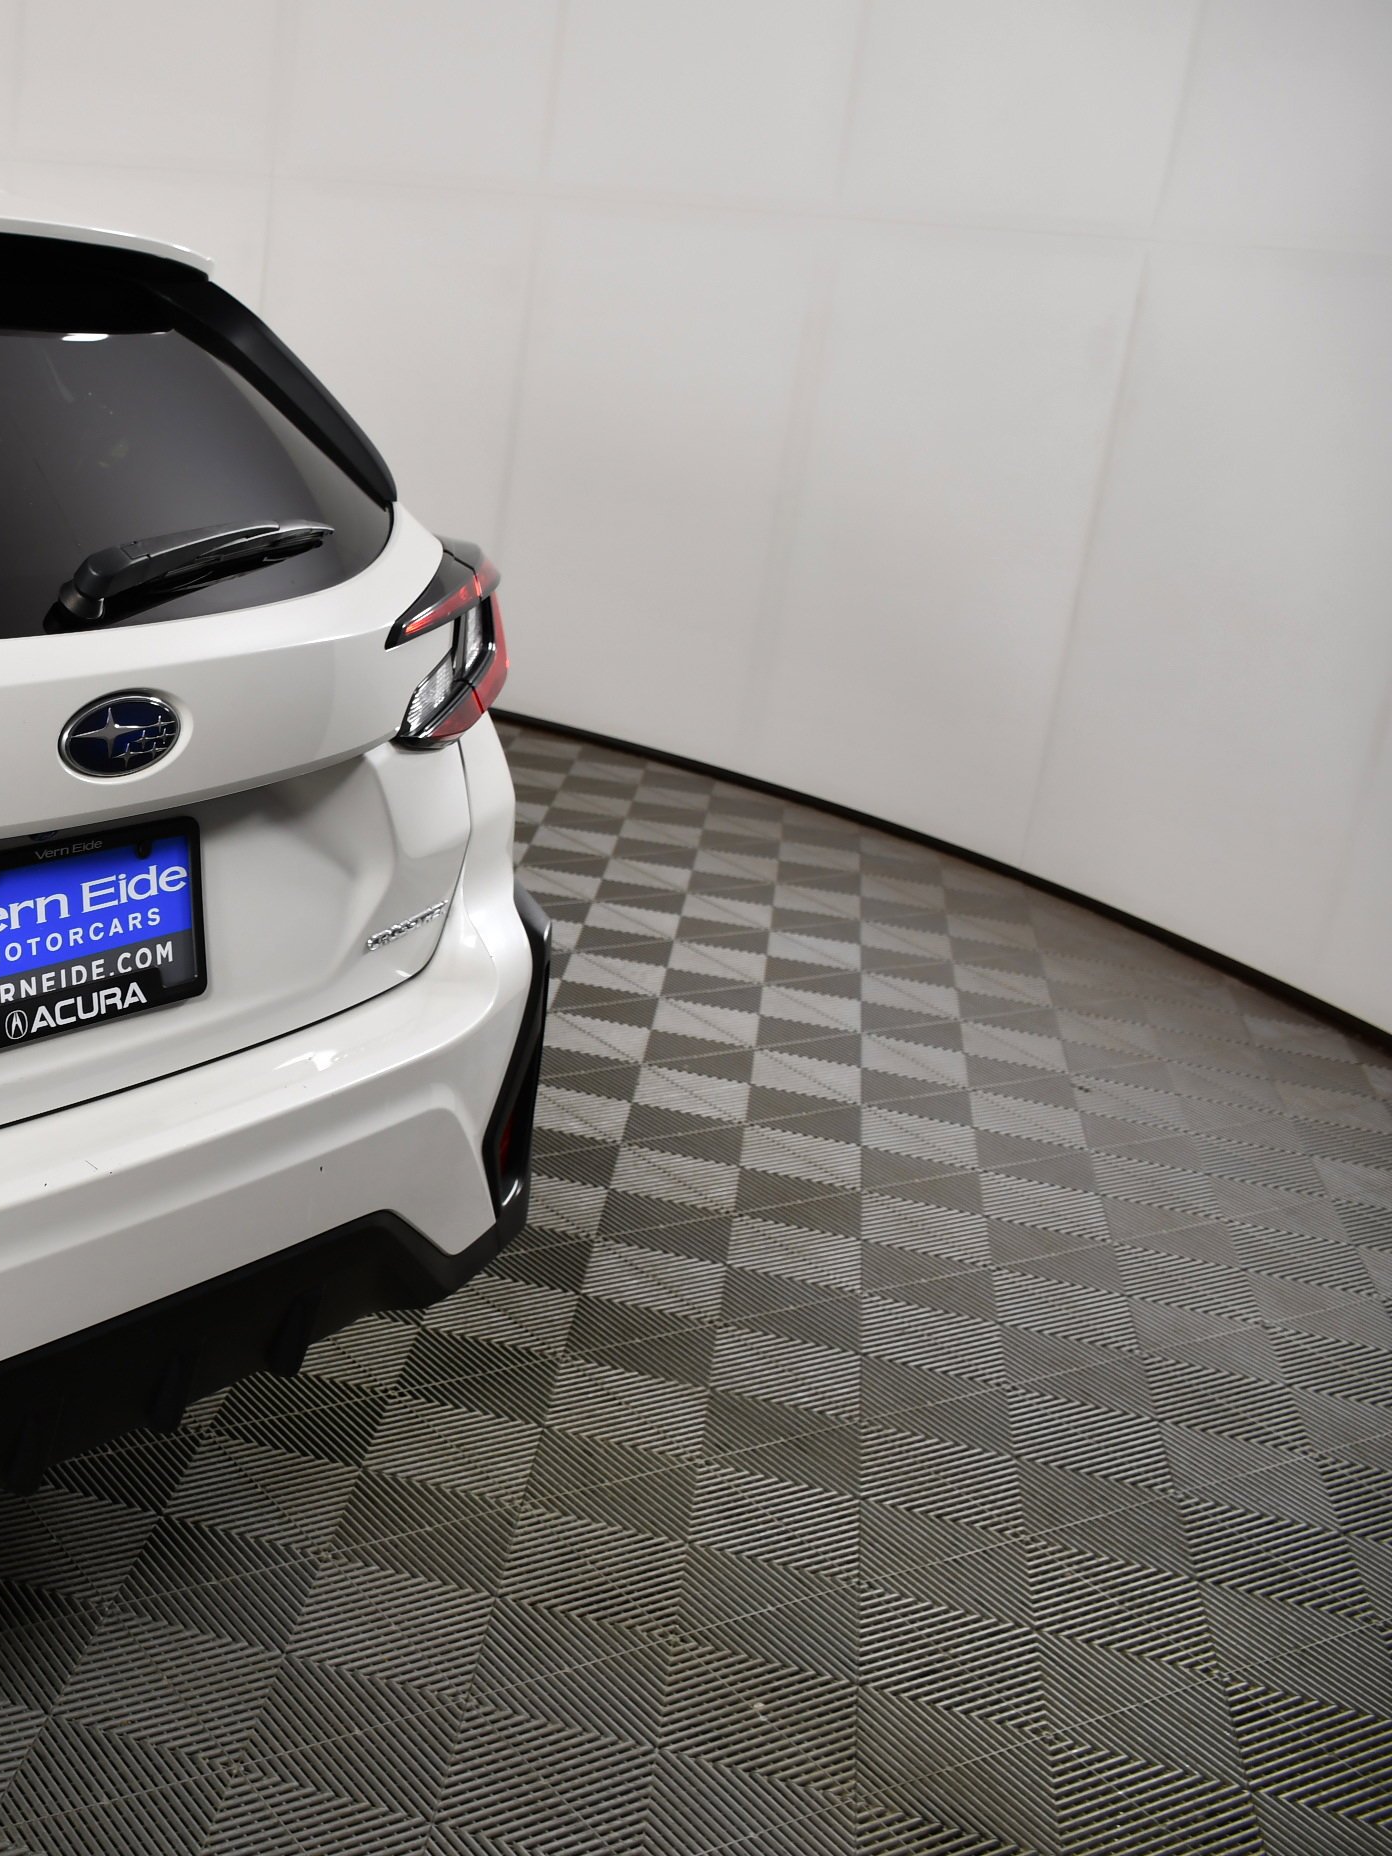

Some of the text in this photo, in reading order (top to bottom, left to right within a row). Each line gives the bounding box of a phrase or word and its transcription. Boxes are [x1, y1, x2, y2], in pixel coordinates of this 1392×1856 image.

[35, 839, 103, 860] Vern Eide
[80, 865, 188, 913] Eide
[31, 982, 147, 1033] ACURA
